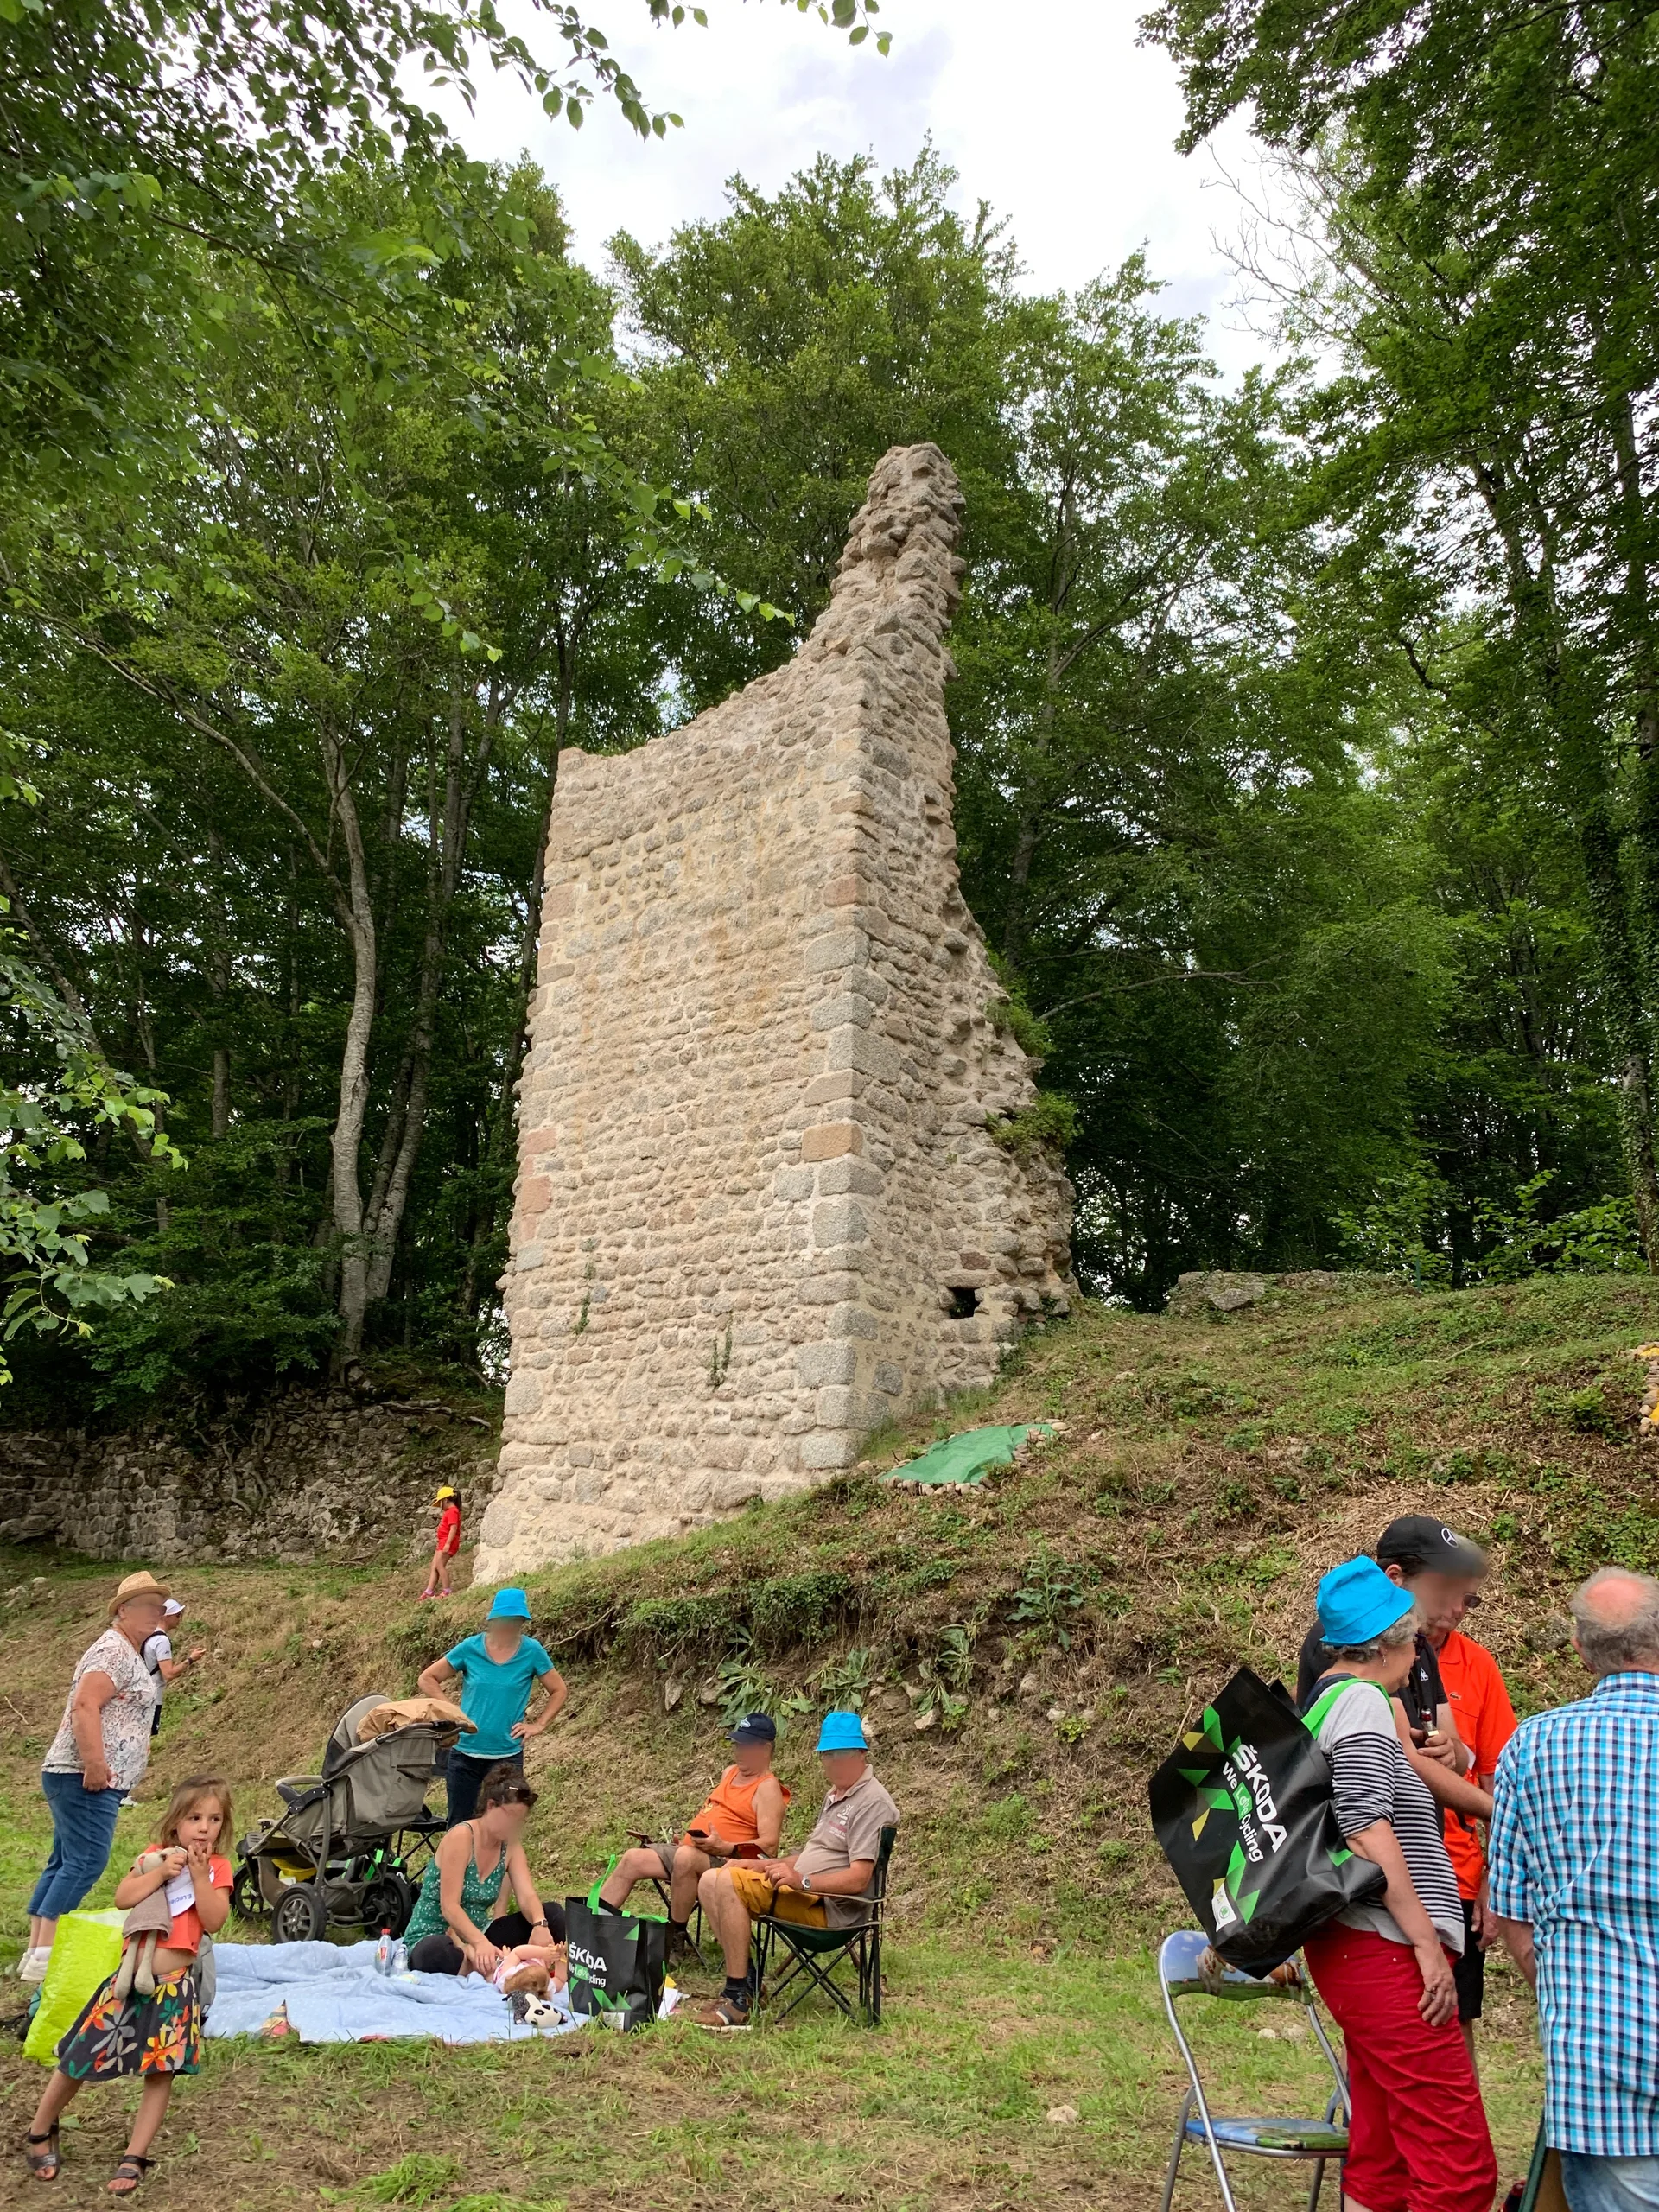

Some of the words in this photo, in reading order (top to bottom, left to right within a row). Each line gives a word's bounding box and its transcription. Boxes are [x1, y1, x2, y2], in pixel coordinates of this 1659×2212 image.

[1223, 1761, 1237, 1789] We
[1239, 1813, 1264, 1863] Cycling
[1232, 1744, 1287, 1853] ŠKODA
